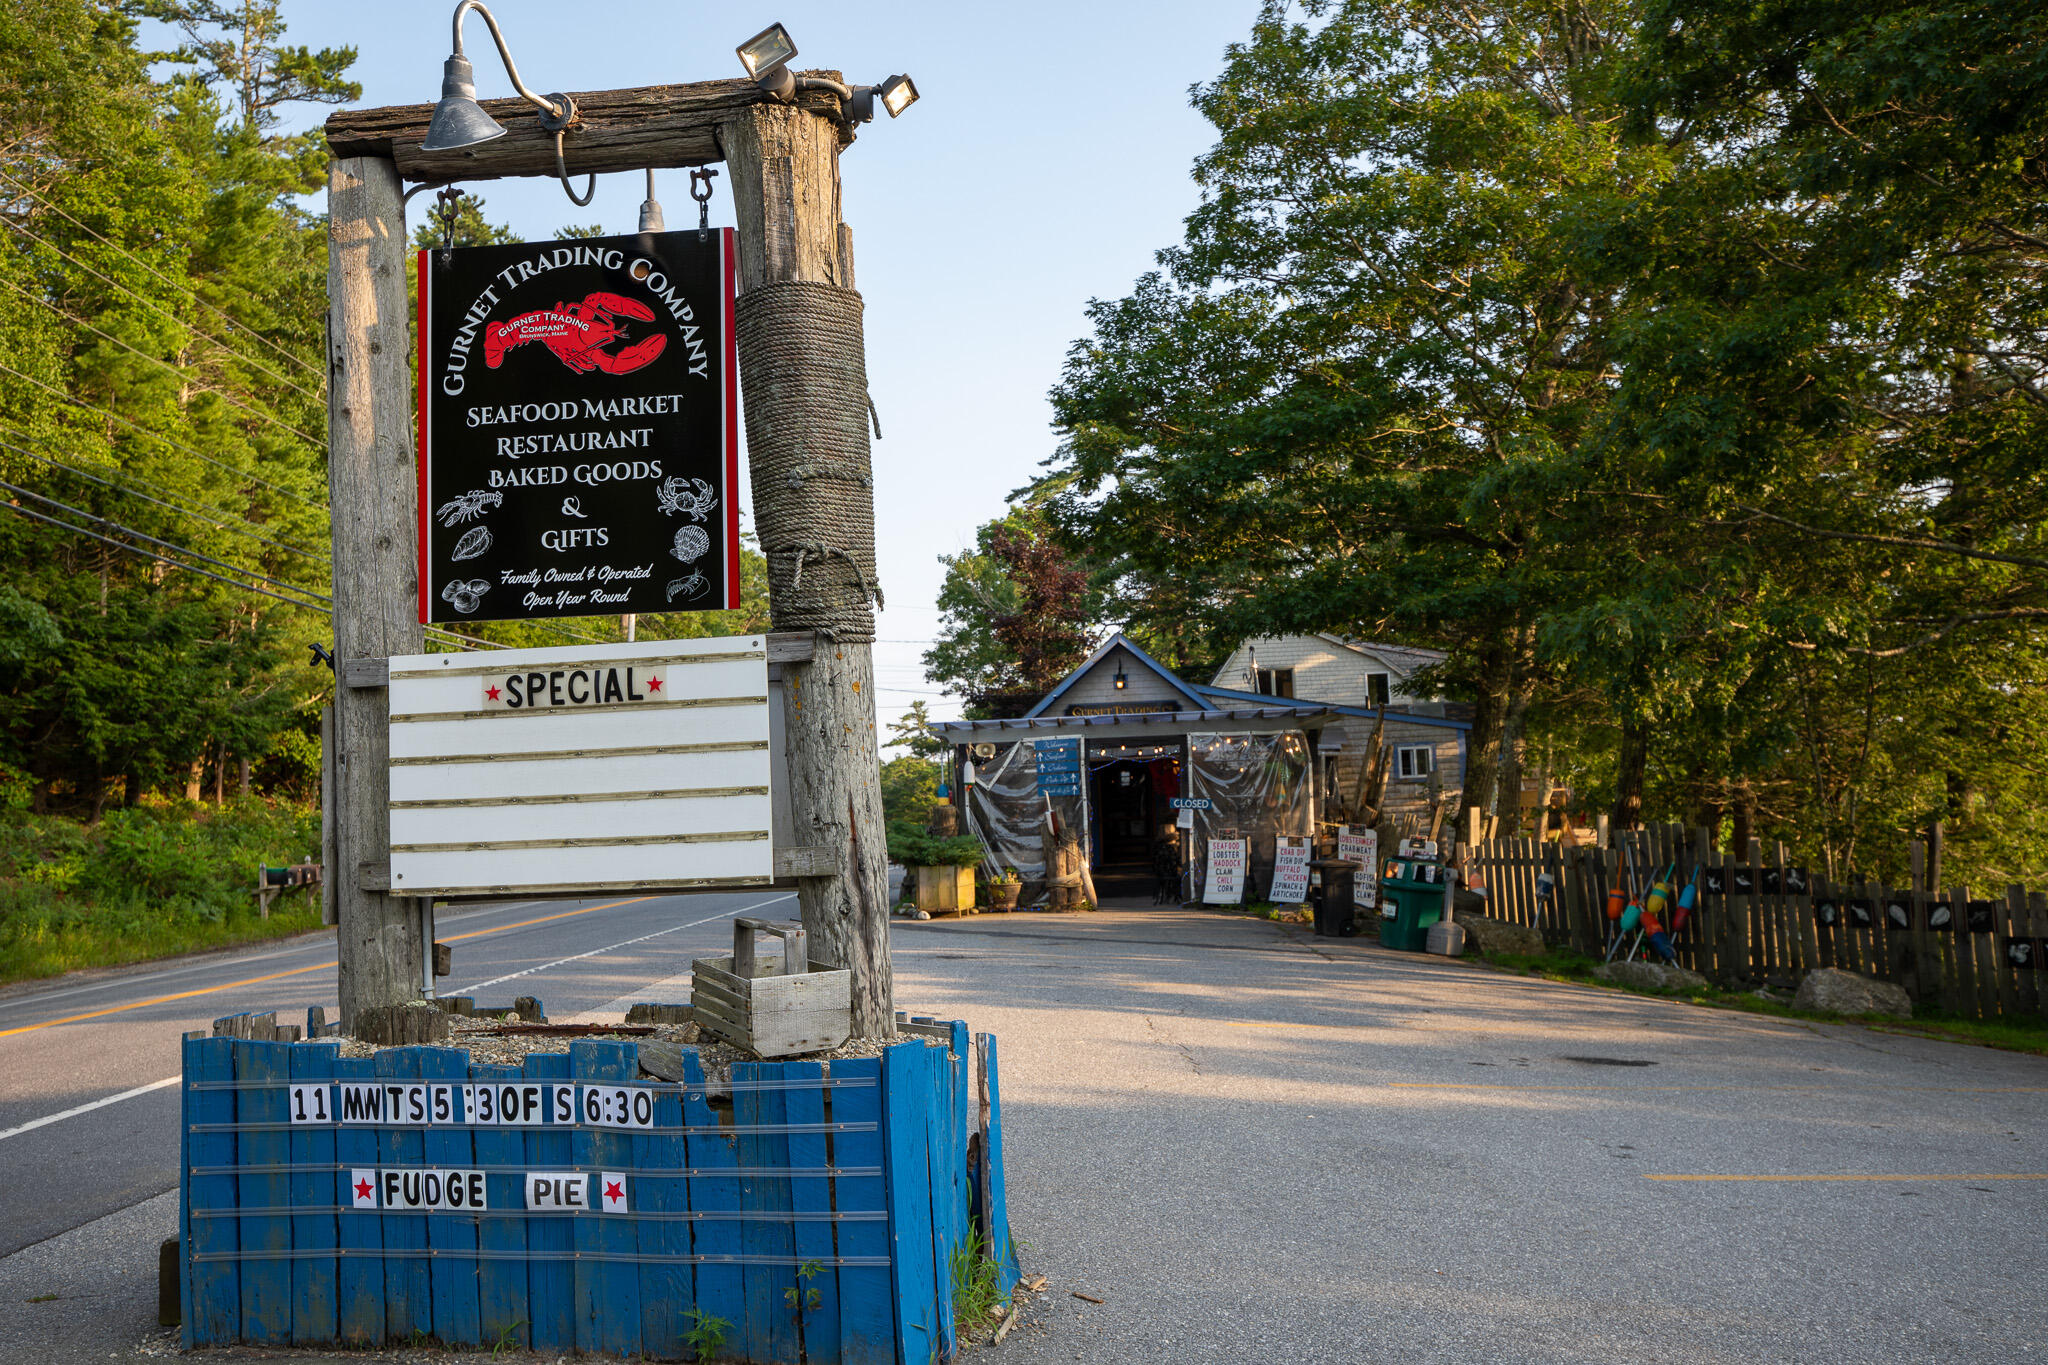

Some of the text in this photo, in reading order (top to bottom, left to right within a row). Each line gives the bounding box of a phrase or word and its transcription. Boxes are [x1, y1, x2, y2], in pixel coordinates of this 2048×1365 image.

[443, 246, 709, 396] GURNET TRADING COMPANY
[498, 312, 590, 337] GURNET TRADING
[520, 324, 565, 334] COMPANY
[466, 394, 684, 428] SEAFOOD MARKET
[496, 428, 654, 459] RESTAURANT
[488, 460, 663, 488] BAKED GOODS
[561, 495, 588, 518] &
[541, 528, 609, 552] GIFTS
[500, 563, 654, 587] Family Owned & Operated
[522, 587, 632, 611] Open Year Round
[505, 667, 644, 708] SPECIAL
[1072, 706, 1112, 717] GURNET
[1112, 704, 1158, 715] TRADING
[1173, 799, 1209, 809] CLOSED
[1212, 842, 1240, 850] SEAFOOD
[1340, 843, 1371, 855] CRABMEAT
[1212, 850, 1240, 859] LOBSTER
[1280, 848, 1306, 857] CRAB DIP
[1213, 859, 1241, 868] HADDOCK
[1280, 856, 1304, 865] FISH DIP
[1215, 868, 1233, 876] CLAM
[1275, 865, 1300, 873] BUFFALO
[1216, 876, 1233, 884] CHILI
[1283, 873, 1307, 882] CHICKEN
[1217, 884, 1234, 893] CORN
[1273, 881, 1298, 890] SPINACH
[1271, 890, 1304, 899] ARTICHOKE
[294, 1087, 328, 1121] 11
[385, 1172, 583, 1208] FUDGE PIE
